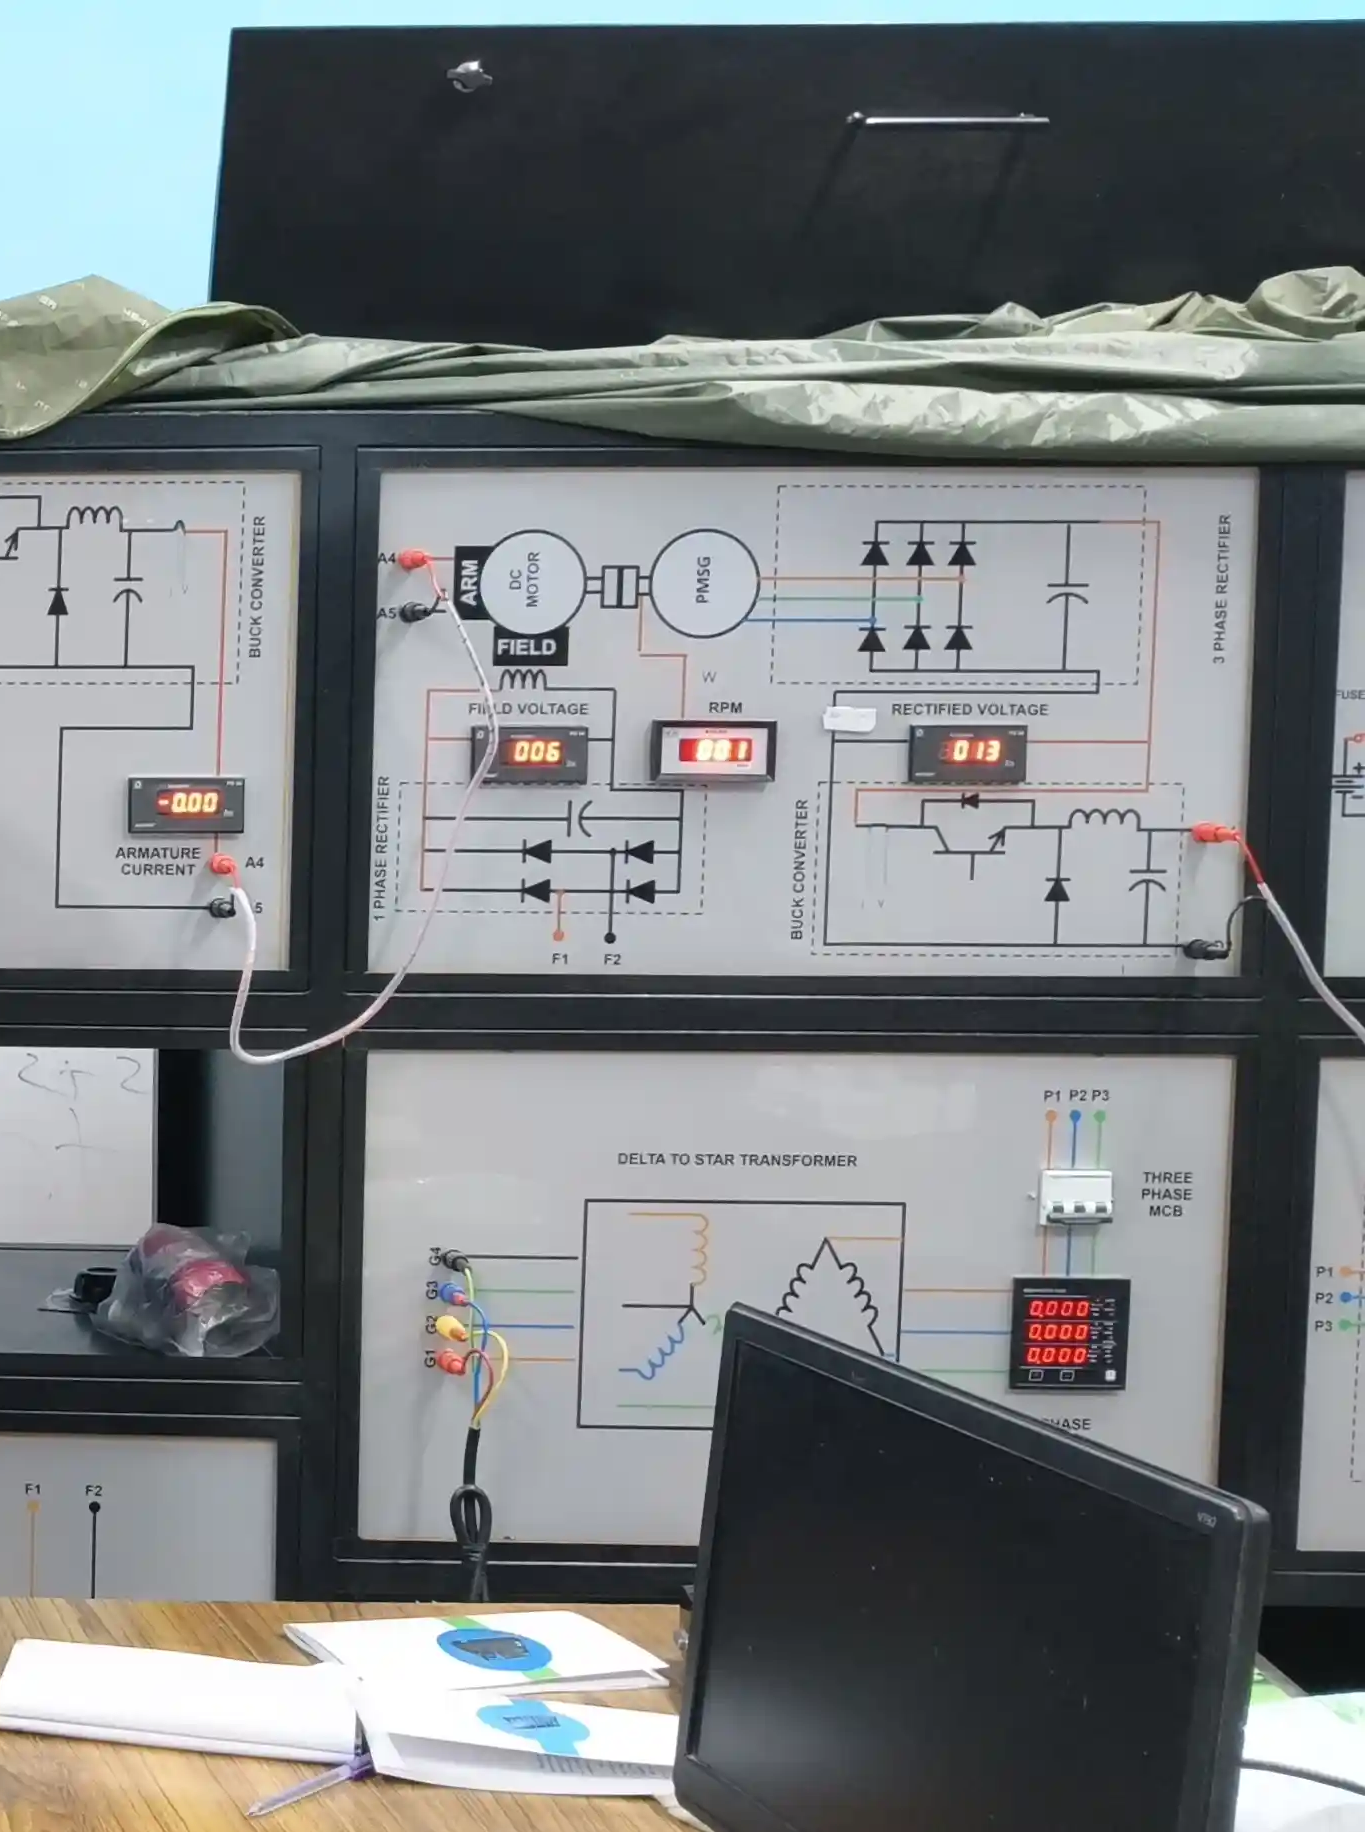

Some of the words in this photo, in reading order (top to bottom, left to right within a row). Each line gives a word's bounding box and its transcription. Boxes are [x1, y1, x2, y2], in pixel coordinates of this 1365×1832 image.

[378, 552, 396, 563] A4
[1215, 514, 1232, 595] RECTIFIER
[250, 515, 266, 611] CONVERTER
[459, 559, 478, 606] ARM
[509, 569, 522, 590] DC
[526, 551, 541, 607] MOTOR
[696, 556, 711, 603] PMSG
[377, 607, 397, 619] A5
[1213, 599, 1228, 652] PHASE
[248, 615, 263, 658] BUCK
[497, 638, 557, 655] FIELD
[1213, 656, 1225, 664] 3
[518, 703, 589, 715] VOLTAGE
[709, 702, 743, 713] RPM
[892, 703, 973, 716] RECTIFIED
[978, 704, 1049, 716] VOLTAGE
[514, 741, 561, 762] 006
[696, 739, 748, 761] 001
[375, 776, 389, 854] RECTIFIER
[115, 847, 201, 859] ARMATURE
[793, 799, 808, 893] CONVERTER
[121, 863, 196, 875] CURRENT
[245, 856, 264, 868] A4
[373, 857, 387, 909] PHASE
[790, 898, 804, 940] BUCK
[552, 953, 568, 965] F1
[604, 953, 621, 965] F2
[1044, 1090, 1061, 1102] P1
[1069, 1090, 1087, 1102] P2
[1092, 1090, 1110, 1102] P3
[618, 1152, 665, 1165] DELTA
[670, 1153, 690, 1166] TO
[694, 1153, 735, 1166] STAR
[740, 1154, 858, 1167] TRANSFORMER
[1143, 1172, 1193, 1184] THREE
[1142, 1188, 1193, 1201] PHASE
[1149, 1205, 1183, 1217] MCB
[429, 1247, 441, 1266] G4
[1315, 1266, 1333, 1278] P1
[426, 1281, 438, 1300] G3
[1315, 1292, 1333, 1304] P2
[1029, 1300, 1089, 1318] 0.000
[425, 1315, 437, 1334] G2
[1028, 1324, 1088, 1340] 0.000
[1315, 1320, 1333, 1332] P3
[424, 1350, 436, 1368] G1
[1027, 1347, 1087, 1364] 0.000
[25, 1483, 41, 1495] F1
[85, 1484, 103, 1497] F2
